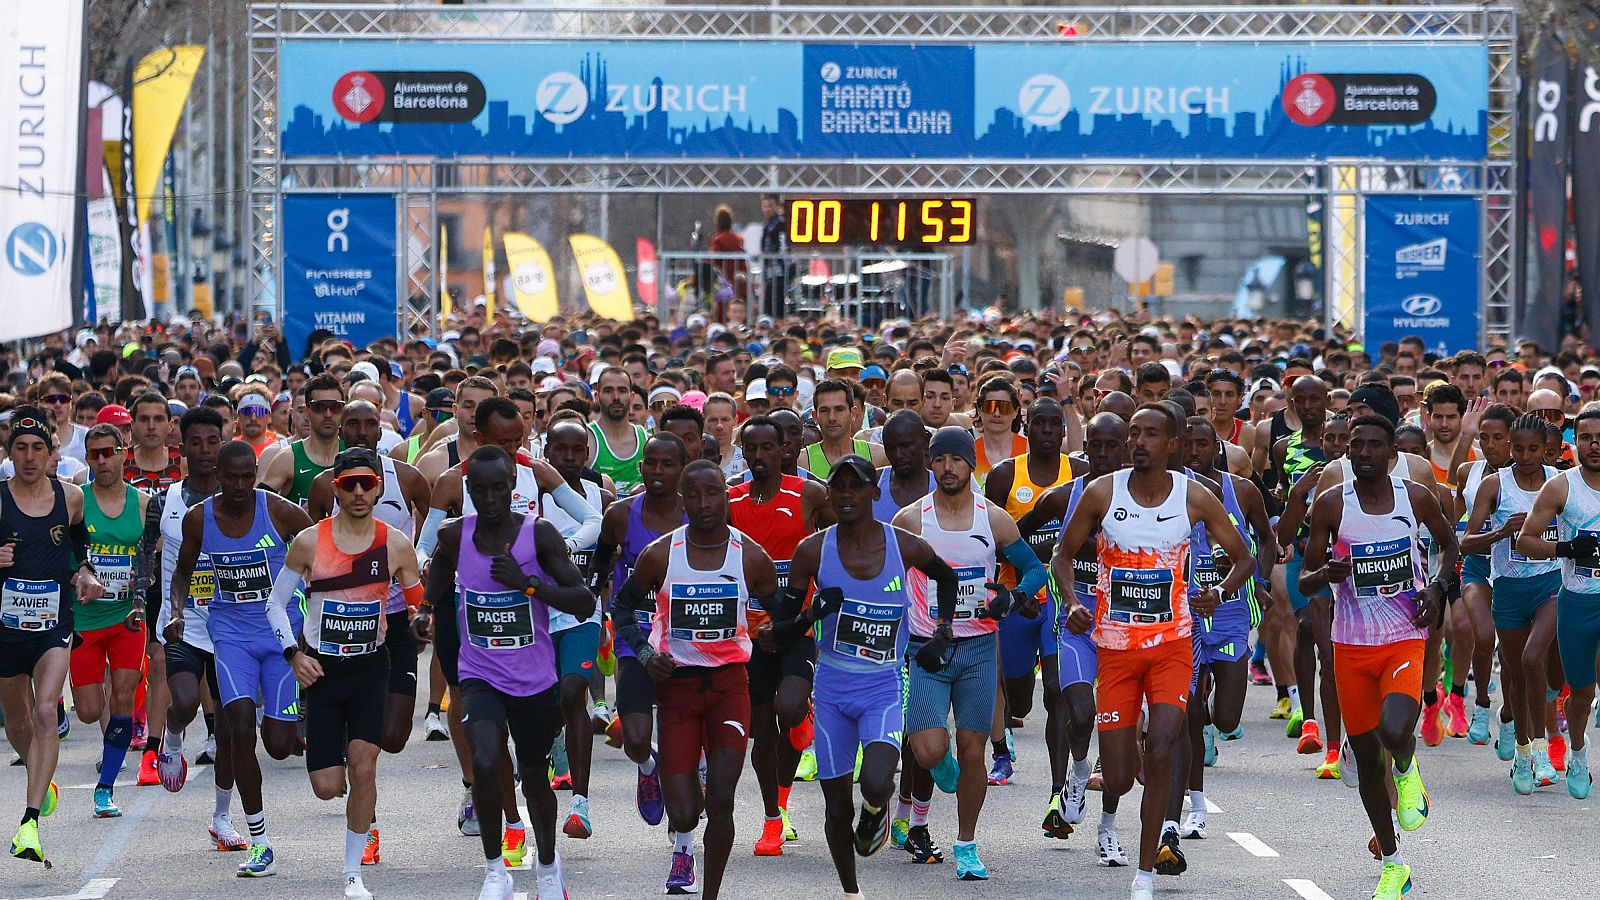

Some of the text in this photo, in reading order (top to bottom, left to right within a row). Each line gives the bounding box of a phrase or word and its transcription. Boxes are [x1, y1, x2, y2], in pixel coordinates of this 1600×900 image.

[844, 66, 898, 79] ZURICH
[393, 81, 468, 95] Ajuntament de
[820, 80, 911, 109] MARATÓ
[1344, 84, 1419, 99] Ajuntament de
[393, 94, 468, 109] Barcelona
[605, 85, 747, 113] ZURICH
[1088, 86, 1230, 114] ZURICH
[1344, 98, 1419, 113] Barcelona
[18, 45, 45, 200] ZURICH
[820, 110, 951, 135] BARCELONA
[790, 199, 972, 243] 00 11 53
[1394, 213, 1450, 226] ZURICH
[305, 269, 373, 280] FINISHERS
[314, 311, 365, 325] VITAMIN
[1393, 317, 1450, 329] HYUNDAI
[1375, 543, 1400, 552] ZURICH
[571, 554, 587, 565] MEI
[1072, 558, 1098, 573] BARS
[1356, 555, 1409, 575] MEKUANT
[100, 571, 129, 580] MIGUEL
[216, 566, 267, 580] BENJAMIN
[1384, 573, 1390, 581] 2
[237, 580, 247, 588] 20
[956, 584, 975, 596] MID
[488, 595, 513, 603] ZURICH
[1121, 586, 1161, 600] NIGUSU
[12, 596, 49, 609] XAVIER
[684, 603, 724, 615] PACER
[1137, 600, 1147, 609] 13
[23, 609, 37, 617] 325
[477, 611, 517, 623] PACER
[868, 608, 893, 616] ZURICH
[325, 618, 375, 631] NAVARRO
[699, 617, 709, 625] 21
[492, 624, 504, 633] 23
[852, 621, 892, 637] PACER
[865, 636, 876, 645] 24
[1096, 711, 1120, 723] EOS
